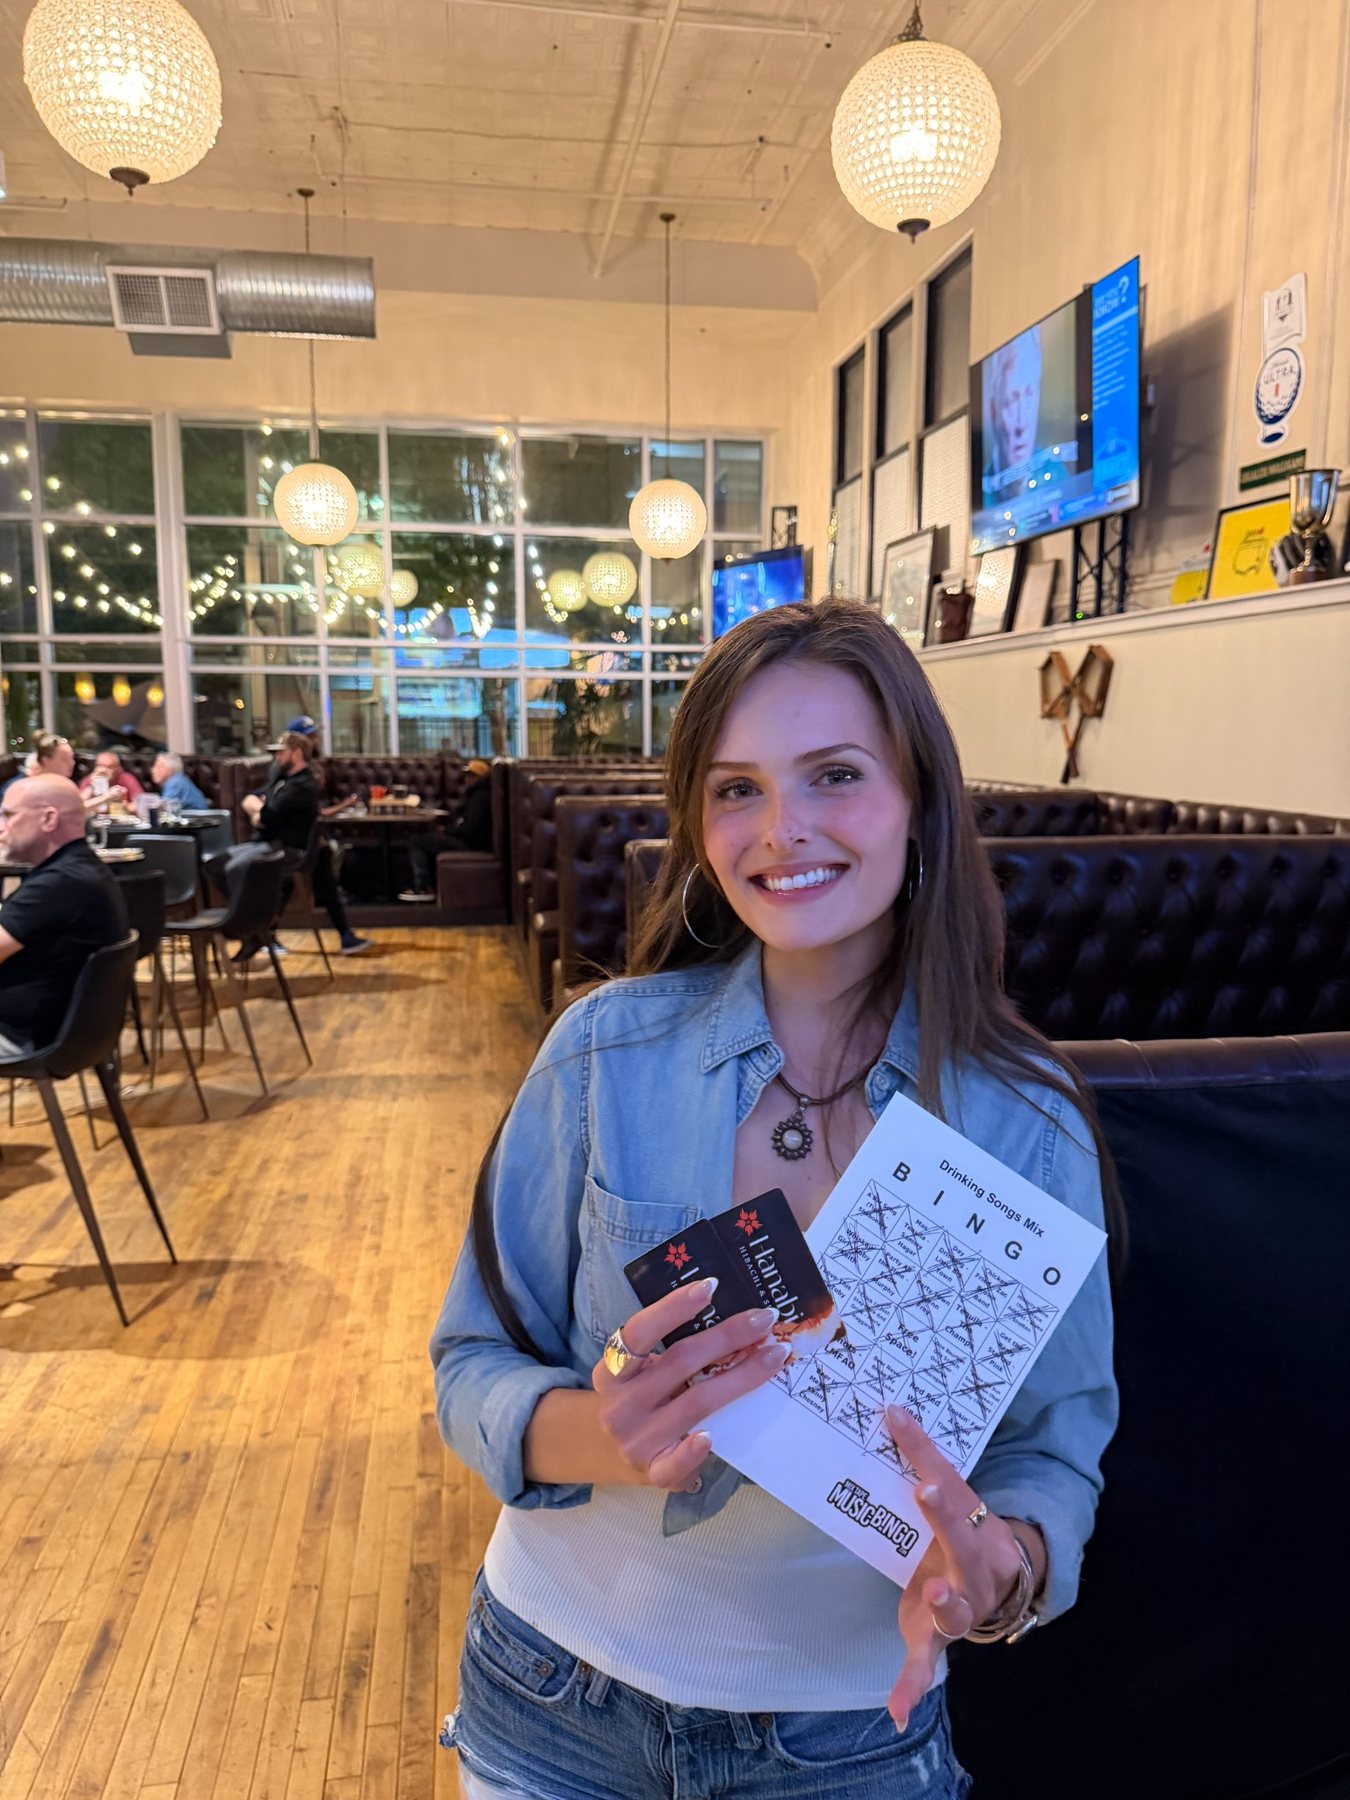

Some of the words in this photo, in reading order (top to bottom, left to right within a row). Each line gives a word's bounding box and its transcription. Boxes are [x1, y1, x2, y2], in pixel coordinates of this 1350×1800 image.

[940, 1160, 985, 1198] Drinking
[987, 1193, 1021, 1221] Songs
[1024, 1218, 1044, 1237] Mix
[893, 1162, 910, 1181] B
[933, 1191, 944, 1206] I
[966, 1213, 985, 1234] N
[1005, 1241, 1022, 1260] G
[1043, 1267, 1060, 1285] O
[902, 1222, 927, 1241] Tequila
[914, 1219, 928, 1230] Mas
[896, 1240, 917, 1257] Hagar
[899, 1231, 923, 1250] Sammy
[884, 1252, 902, 1266] Party
[951, 1245, 965, 1257] Day
[739, 1246, 761, 1288] HIBACHI
[935, 1268, 953, 1282] Town
[750, 1235, 804, 1323] Hanabi
[870, 1277, 895, 1296] urphy
[829, 1284, 846, 1299] Toby
[996, 1287, 1008, 1297] Zac
[973, 1294, 990, 1308] Band
[954, 1304, 984, 1326] Tequila
[896, 1324, 919, 1342] Free
[999, 1332, 1012, 1343] Get
[836, 1336, 858, 1354] hots
[883, 1333, 917, 1358] Space!
[822, 1344, 856, 1370] LMFAO
[988, 1359, 1004, 1372] Pink
[797, 1391, 826, 1413] Chesney
[908, 1382, 925, 1395] Red
[924, 1393, 941, 1406] Red
